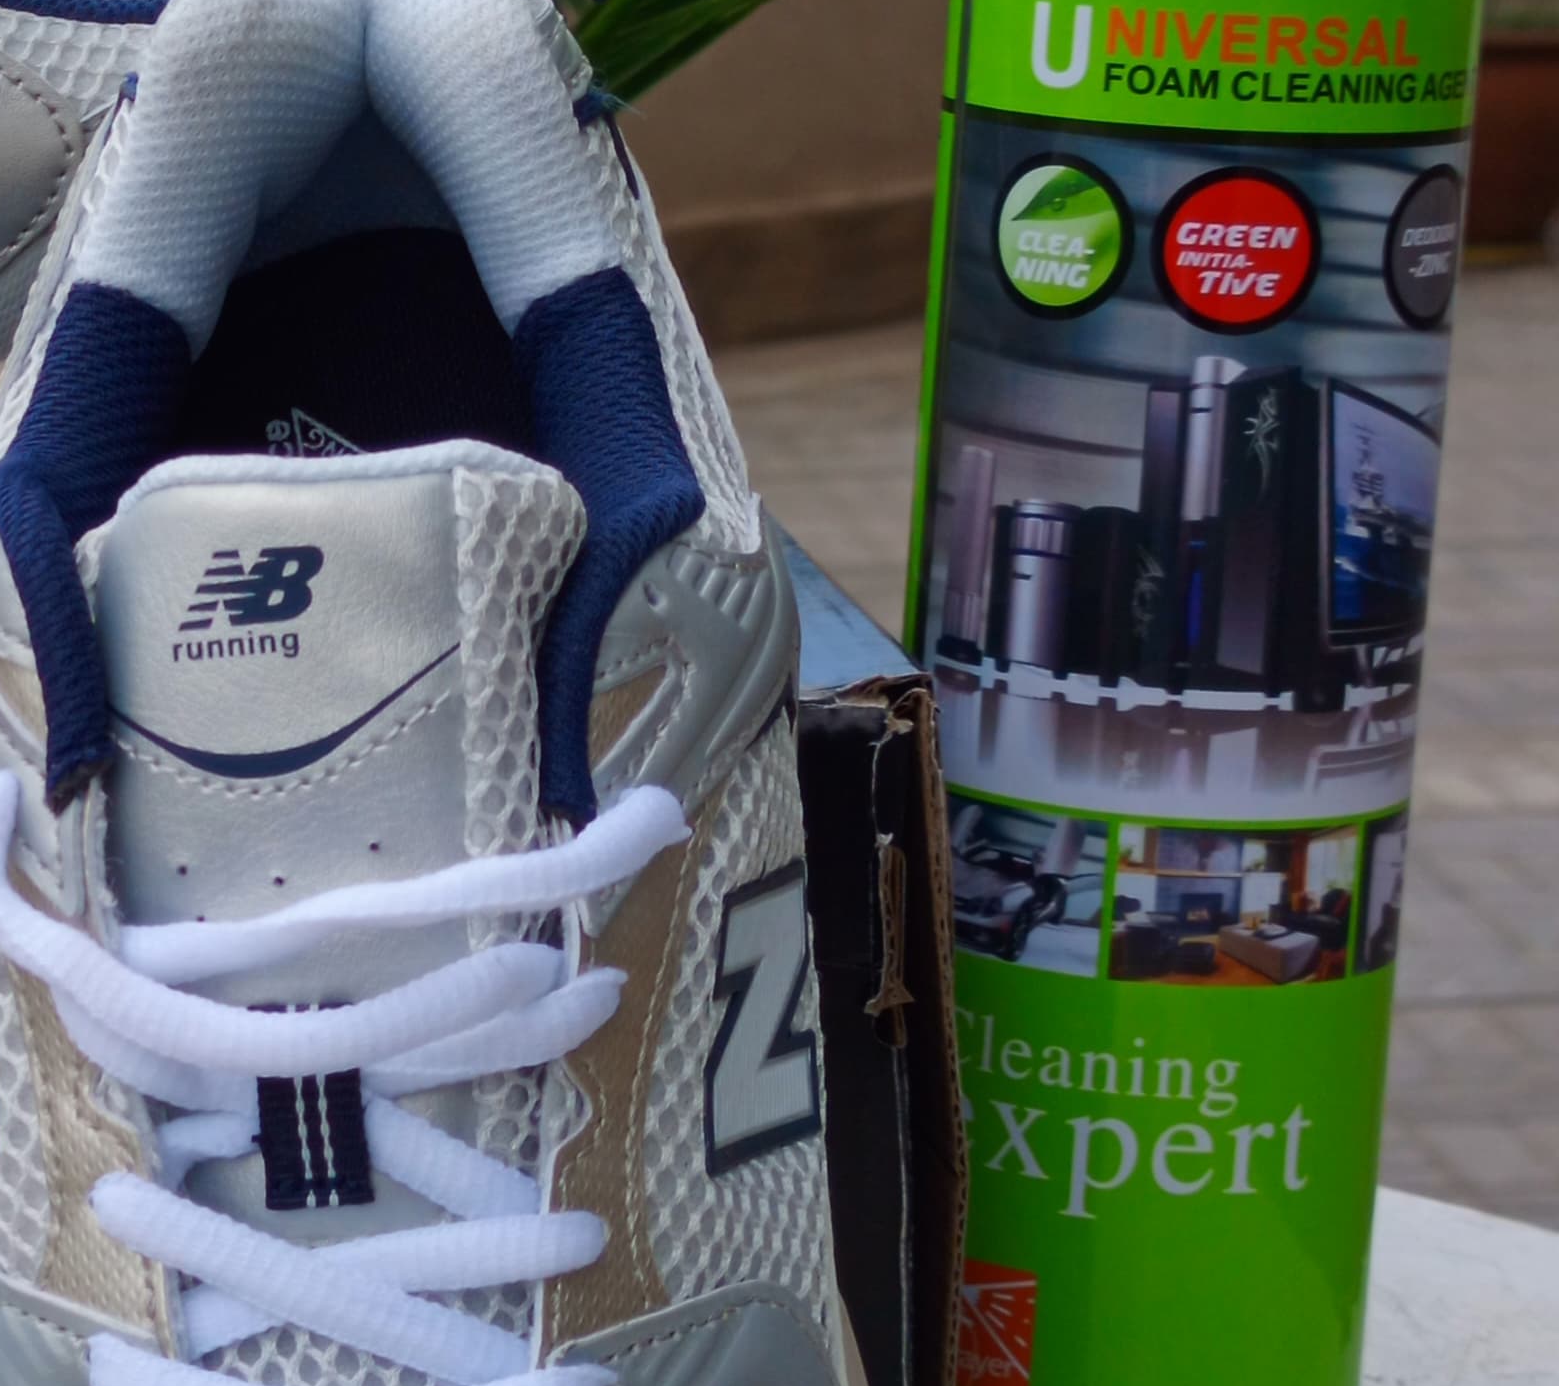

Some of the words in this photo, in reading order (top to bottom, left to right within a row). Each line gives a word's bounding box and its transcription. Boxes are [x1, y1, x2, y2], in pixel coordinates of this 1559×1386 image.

[1103, 63, 1220, 101] FOAM
[1230, 68, 1417, 104] CLEANING
[1176, 222, 1298, 249] GREEN
[1013, 256, 1093, 289] NING
[1177, 250, 1256, 270] INITIA-
[1198, 270, 1282, 298] TIVE
[172, 631, 300, 663] running
[960, 1093, 1313, 1220] xpert
